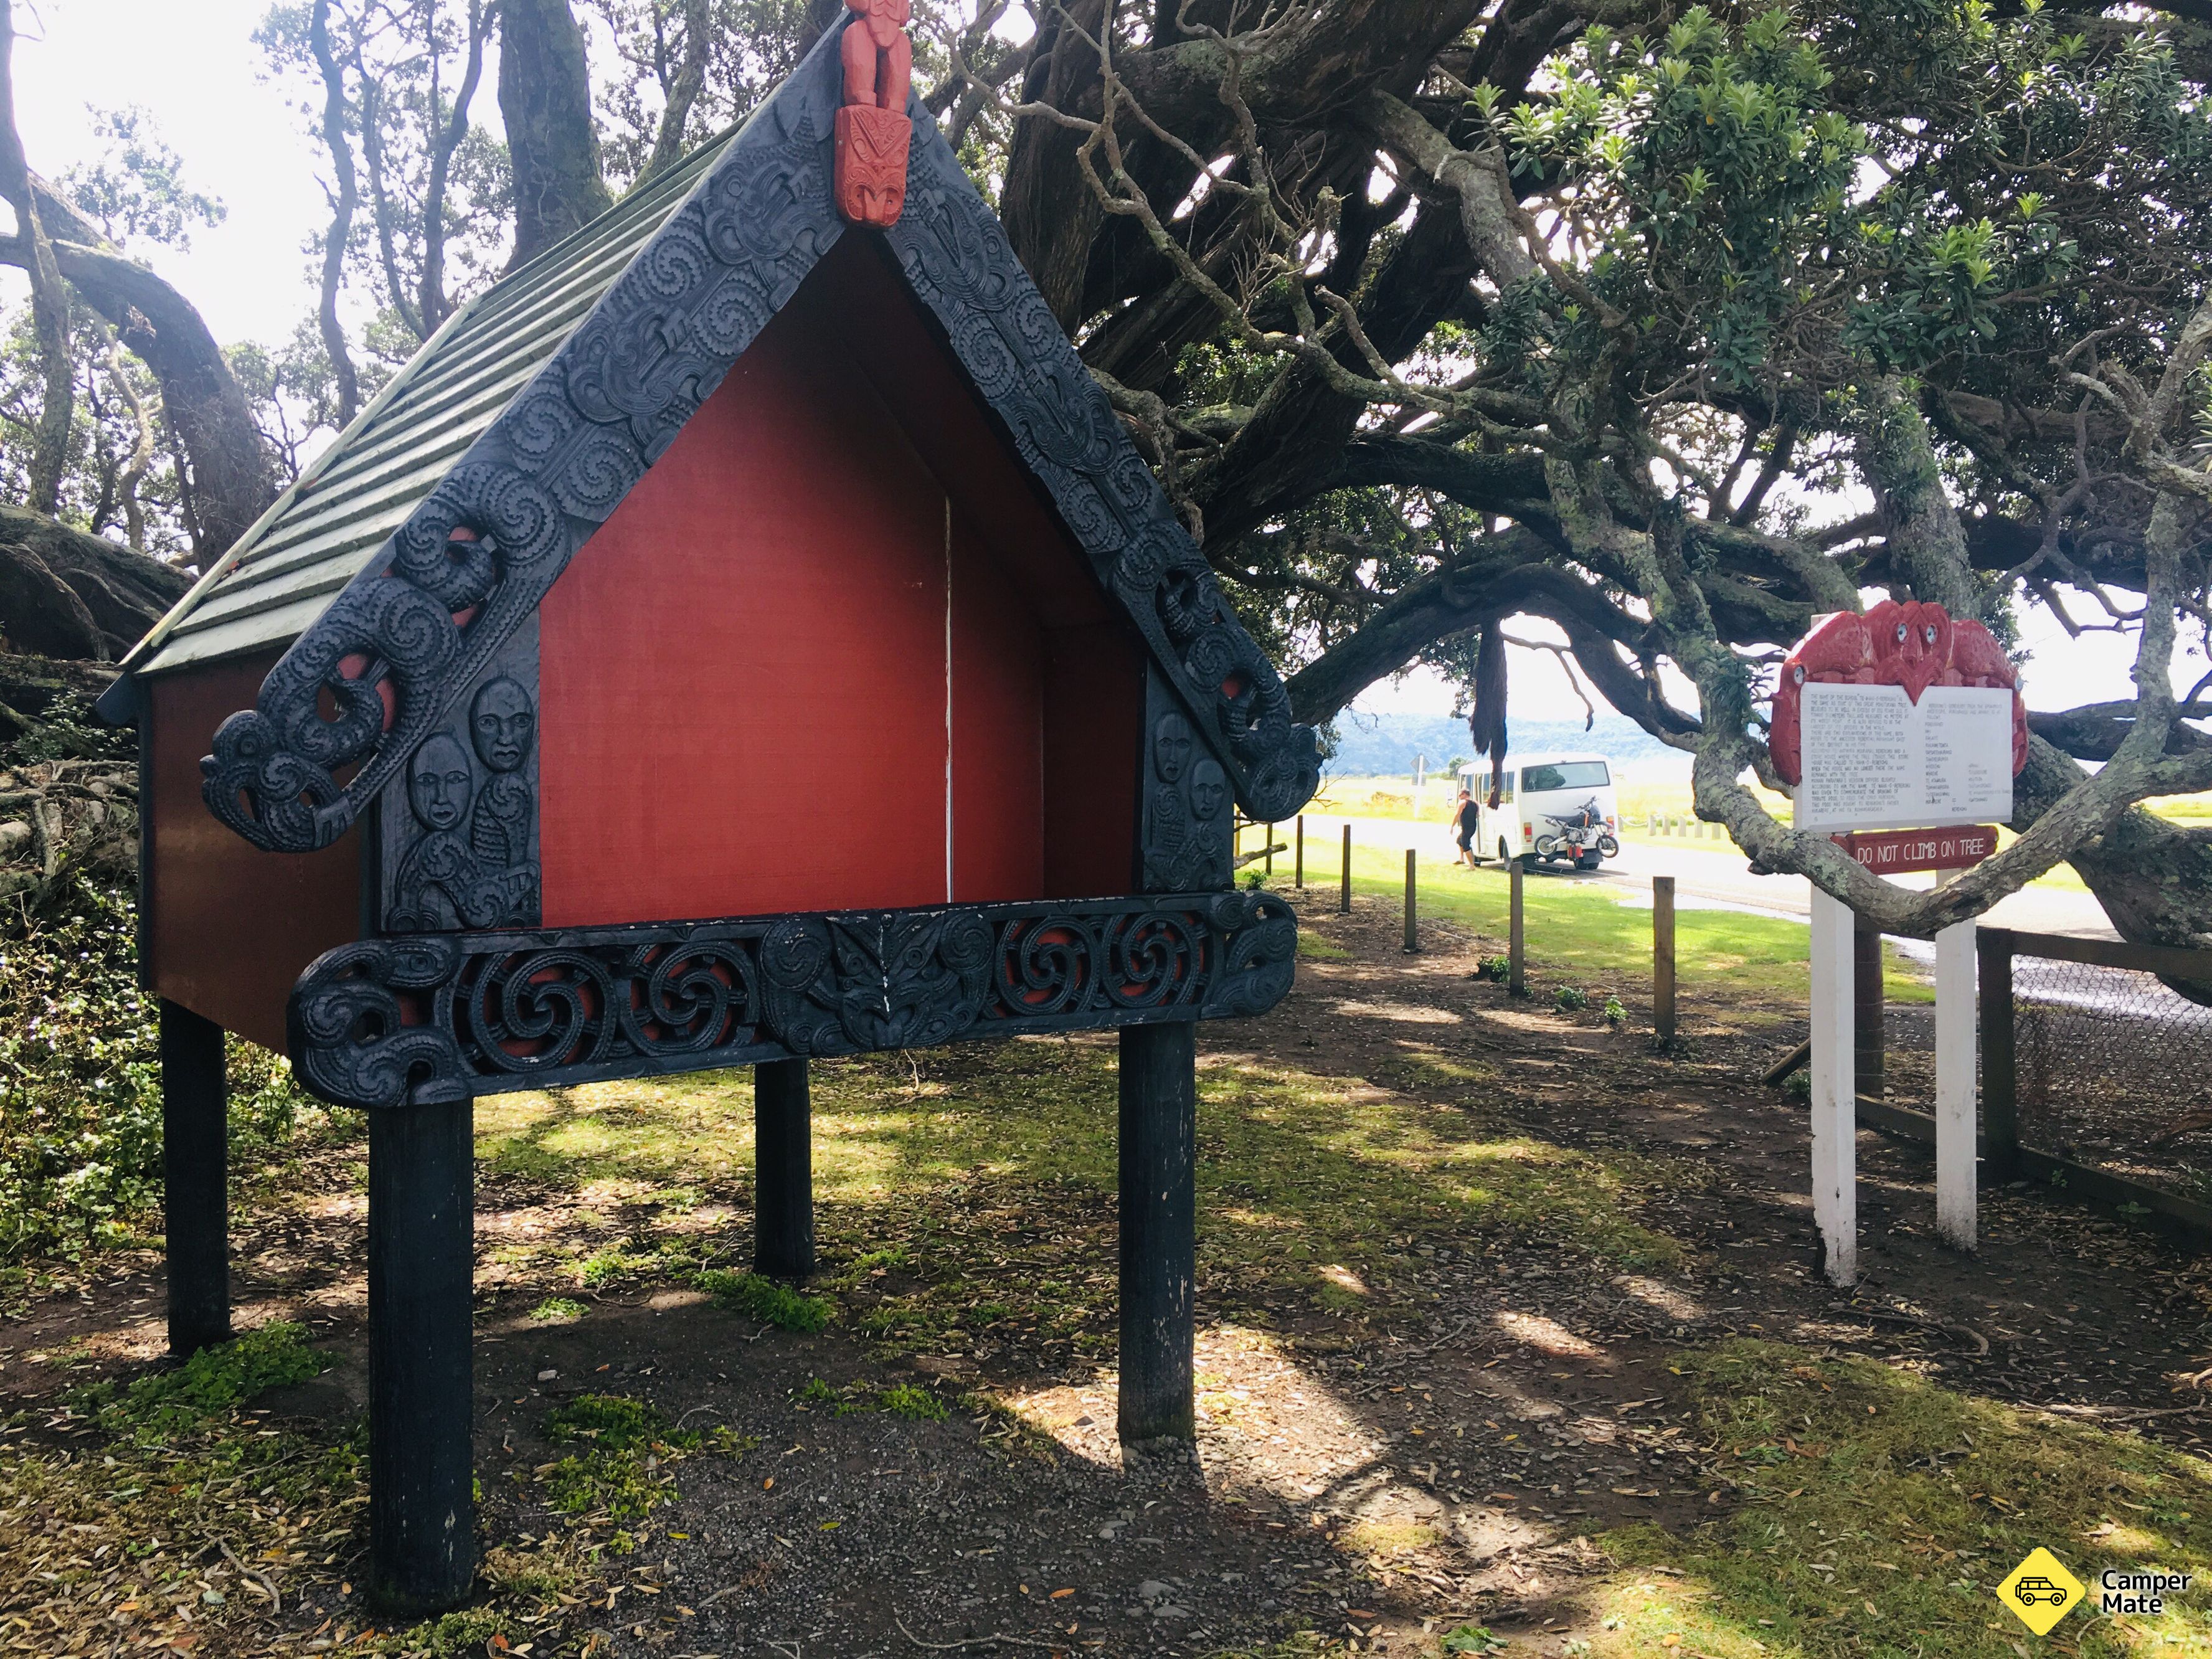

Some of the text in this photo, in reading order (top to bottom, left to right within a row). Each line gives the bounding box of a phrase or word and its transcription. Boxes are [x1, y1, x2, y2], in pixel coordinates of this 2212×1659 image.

[1858, 838, 1984, 864] DO NOT CLIMB ON TREE
